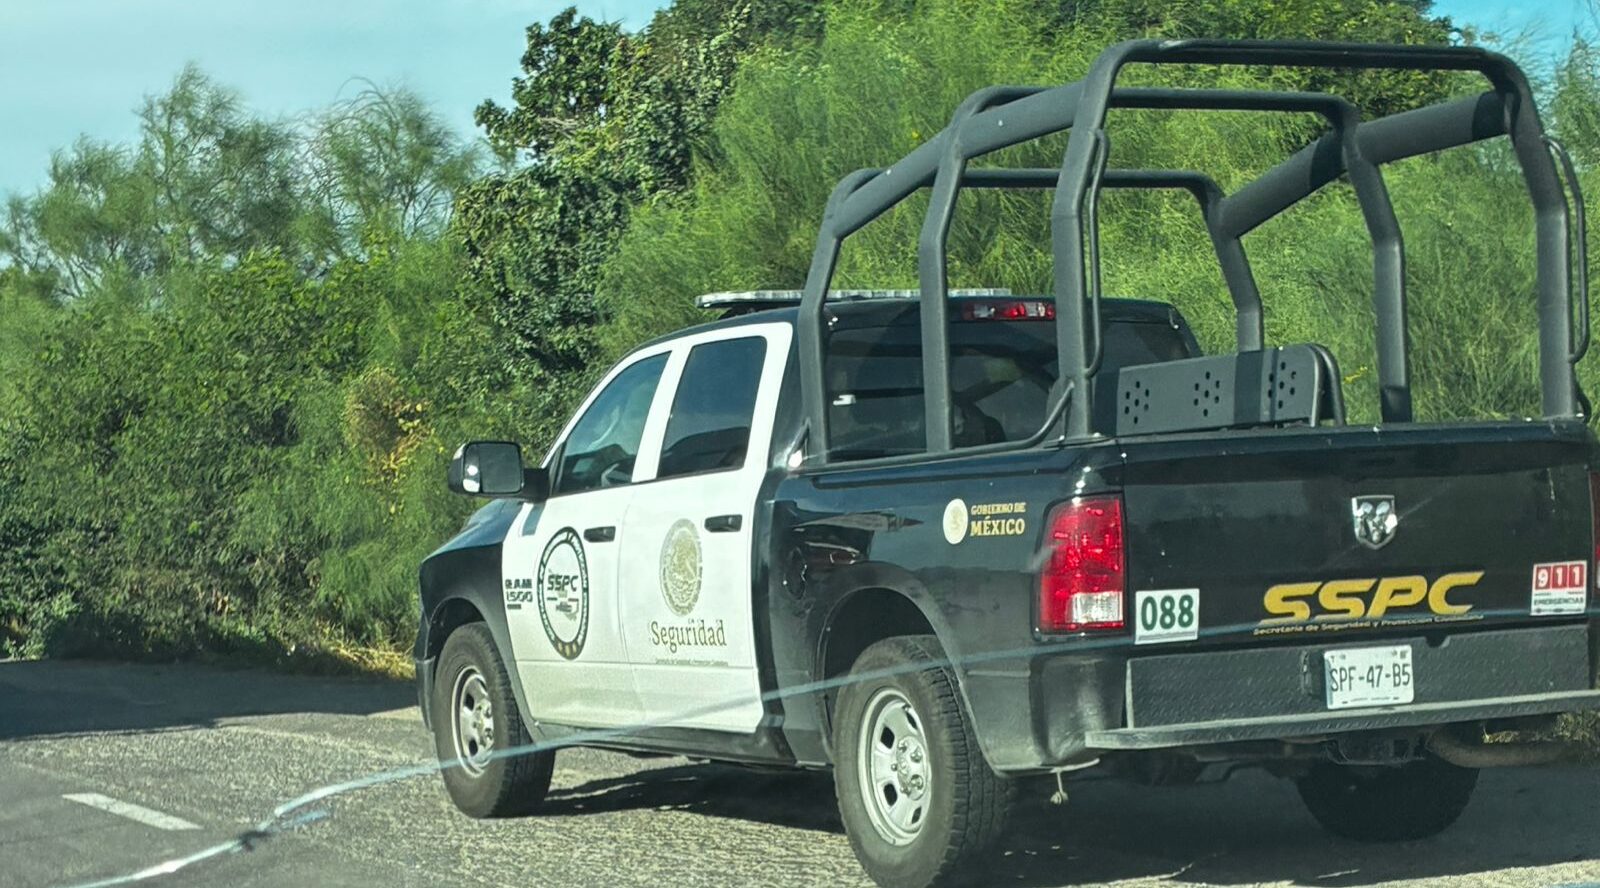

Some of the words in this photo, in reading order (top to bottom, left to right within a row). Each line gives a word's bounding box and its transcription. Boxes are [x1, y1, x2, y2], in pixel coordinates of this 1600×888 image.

[970, 503, 1013, 516] GOBIERNO
[1013, 502, 1027, 513] DE
[969, 516, 1026, 537] MÉXICO
[504, 578, 533, 590] RAM
[546, 574, 579, 592] SSPC
[1537, 566, 1580, 588] 911
[505, 591, 534, 603] 1500
[1258, 570, 1485, 624] SSPC
[1534, 596, 1584, 606] EMERGENCIAS
[1140, 594, 1194, 631] 088
[650, 619, 728, 654] Seguridad
[1329, 662, 1411, 692] SPF-47-B5
